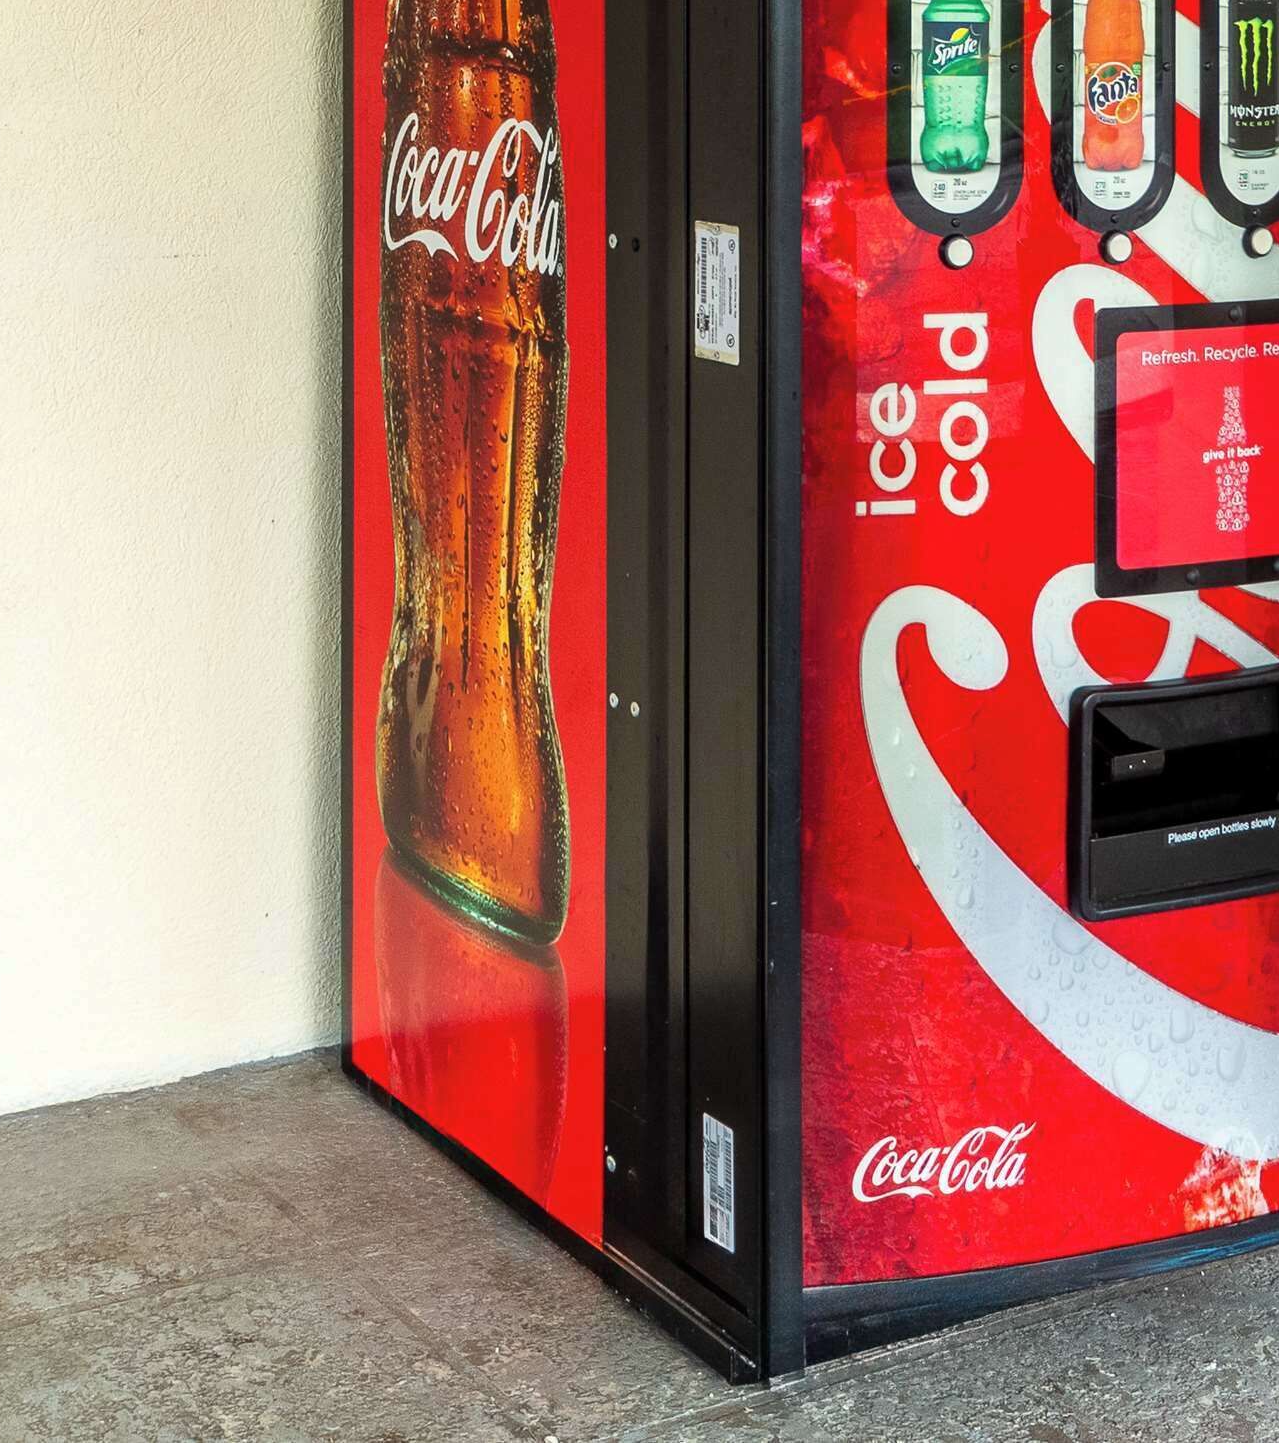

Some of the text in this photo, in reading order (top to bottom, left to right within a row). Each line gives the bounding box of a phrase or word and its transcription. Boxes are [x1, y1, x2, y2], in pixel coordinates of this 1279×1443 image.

[932, 38, 978, 66] Sprite
[1230, 104, 1279, 119] MONSTER
[384, 112, 560, 276] Coca-Cola
[1141, 348, 1200, 366] Refresh.
[1204, 343, 1260, 362] Recycle.
[923, 312, 989, 516] cold
[855, 382, 917, 516] ice
[1202, 444, 1261, 463] give it back
[1168, 815, 1277, 844] Please open bottles slowly
[852, 1121, 1037, 1203] Coca-Cola
